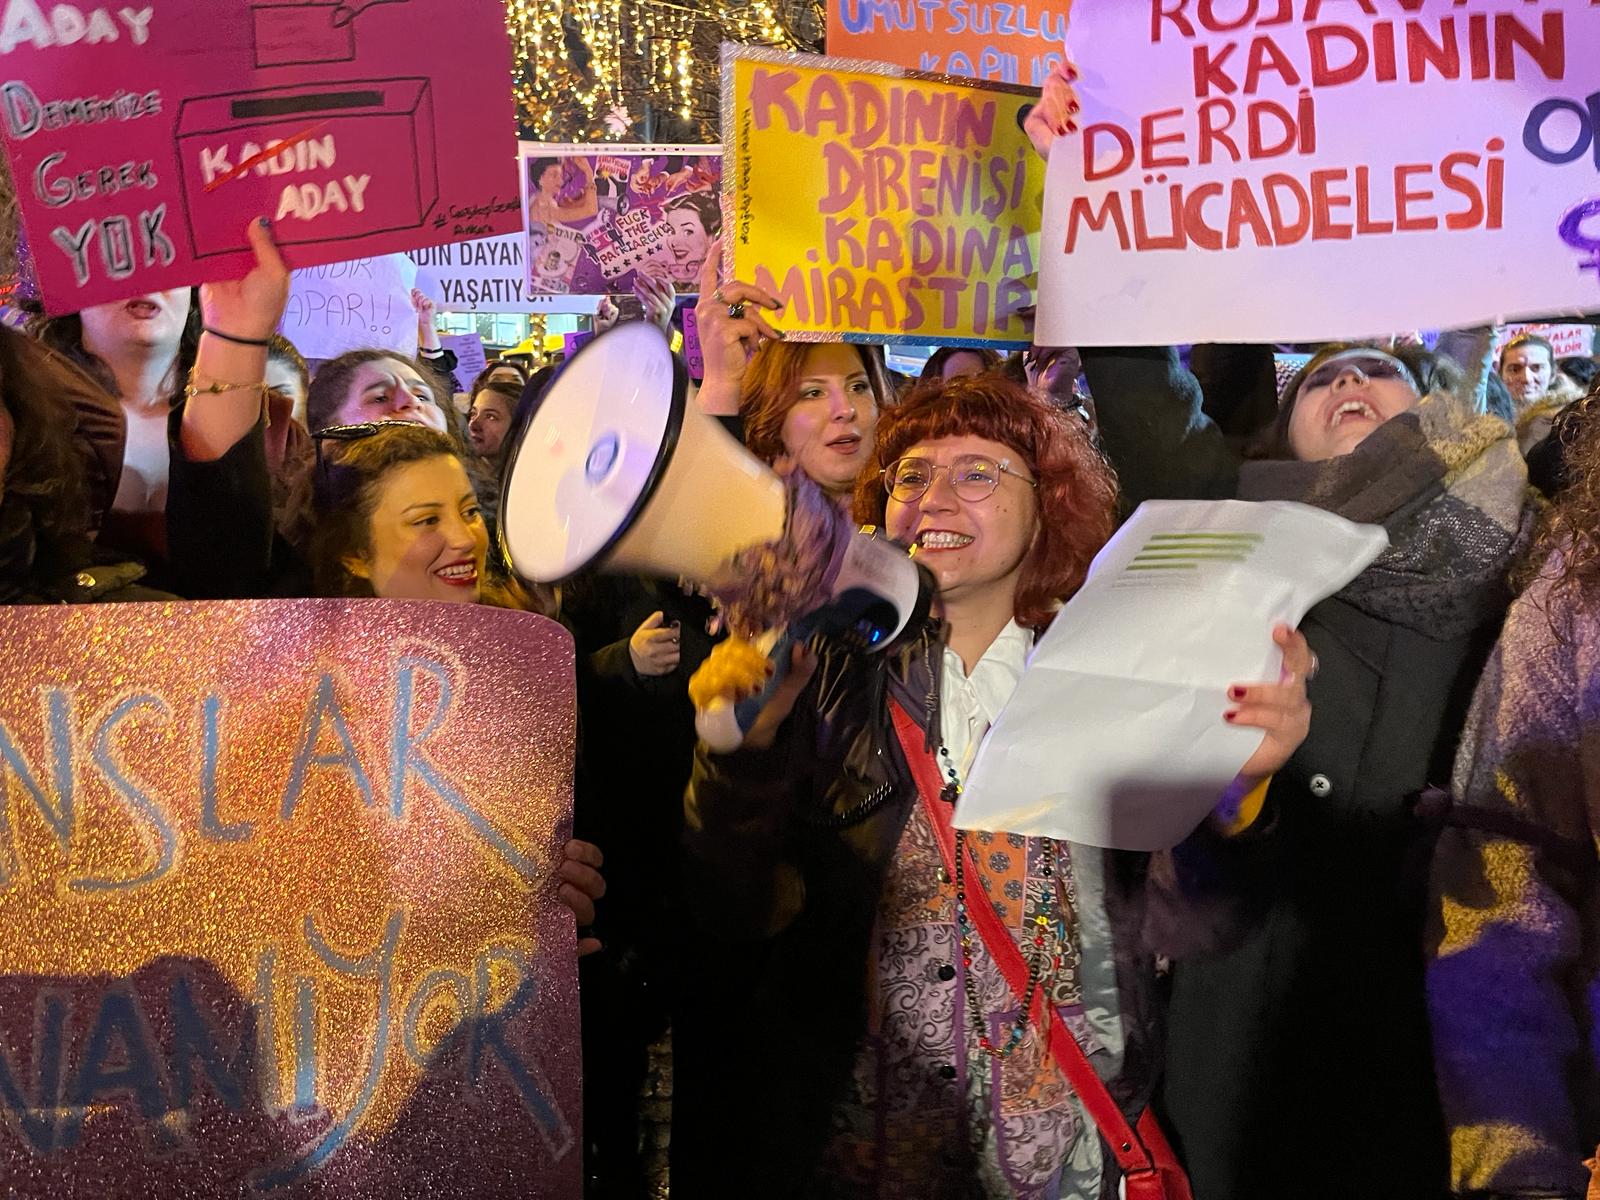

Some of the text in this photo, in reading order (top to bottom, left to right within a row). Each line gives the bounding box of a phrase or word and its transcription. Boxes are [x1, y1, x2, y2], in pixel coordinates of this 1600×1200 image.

[0, 0, 154, 53] ADAY
[1193, 12, 1567, 98] KADININ
[750, 67, 996, 149] KADININ
[1082, 88, 1316, 181] DERDİ
[34, 151, 158, 208] GEREK
[200, 134, 337, 184] KADIN
[273, 173, 372, 221] ADAY
[616, 208, 650, 229] FUCK
[1063, 137, 1506, 254] MÜCADELESİ
[50, 202, 176, 288] YOK
[625, 221, 650, 238] THE
[823, 216, 1034, 278] KADINA
[440, 279, 553, 310] YAŞATIY
[754, 249, 1036, 335] MİRASTIR
